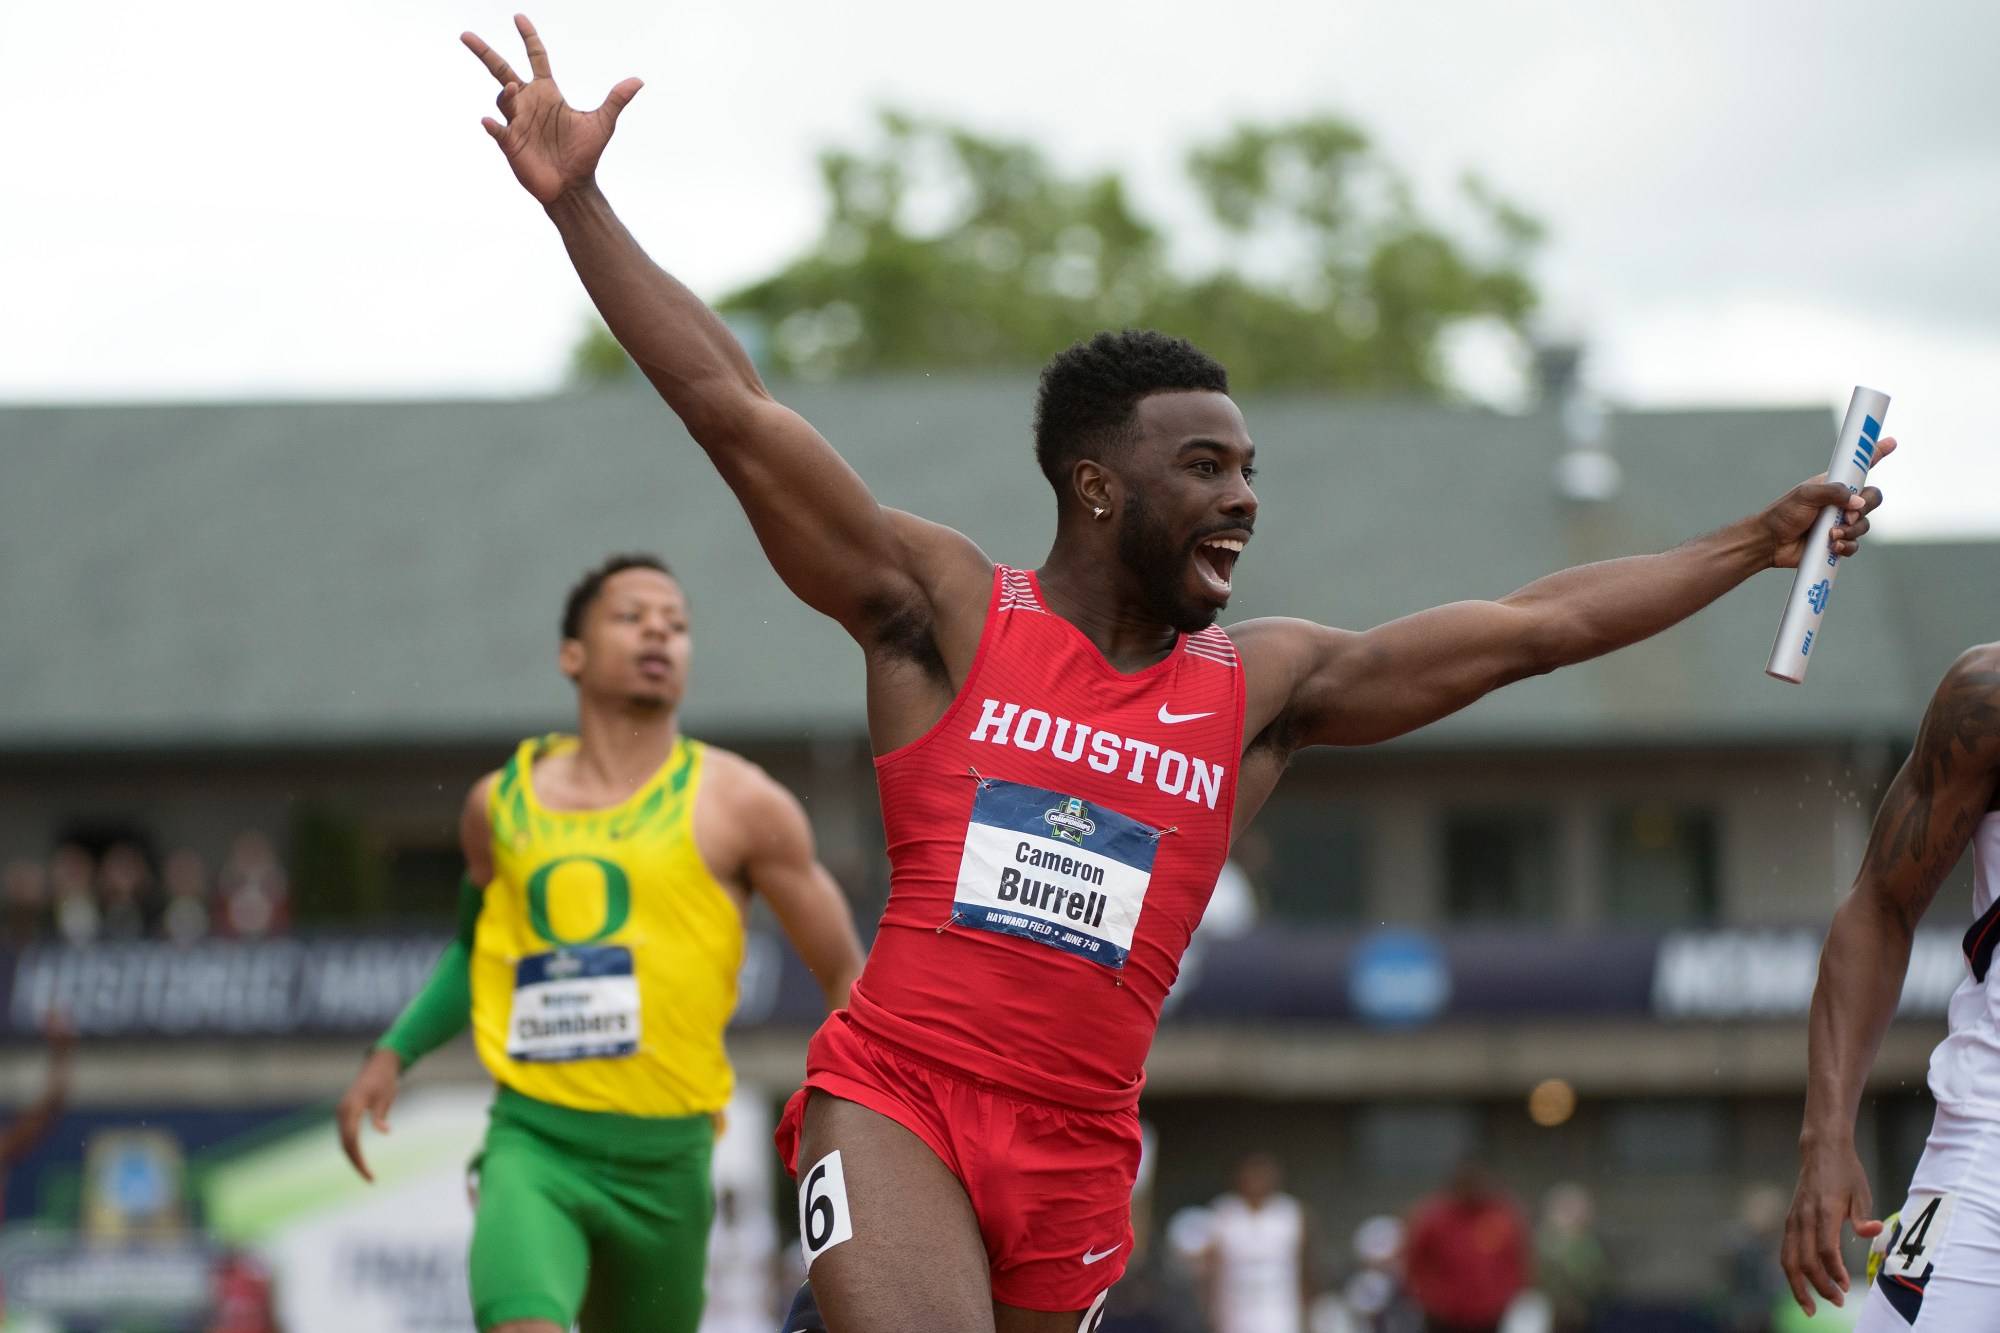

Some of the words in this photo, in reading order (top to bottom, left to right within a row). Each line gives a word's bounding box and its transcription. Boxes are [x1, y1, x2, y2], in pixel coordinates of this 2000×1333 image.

[969, 698, 1224, 811] HOUSTON
[997, 866, 1108, 928] Burrell
[1015, 841, 1105, 886] Cameron
[527, 854, 632, 946] O
[985, 911, 1028, 928] HAYWARD
[1028, 921, 1053, 936] FIELD
[1061, 932, 1084, 947] JUNE
[1083, 939, 1101, 953] 7-10
[517, 1012, 627, 1040] Chambers
[805, 1163, 835, 1252] 6
[1895, 1197, 1943, 1270] 4
